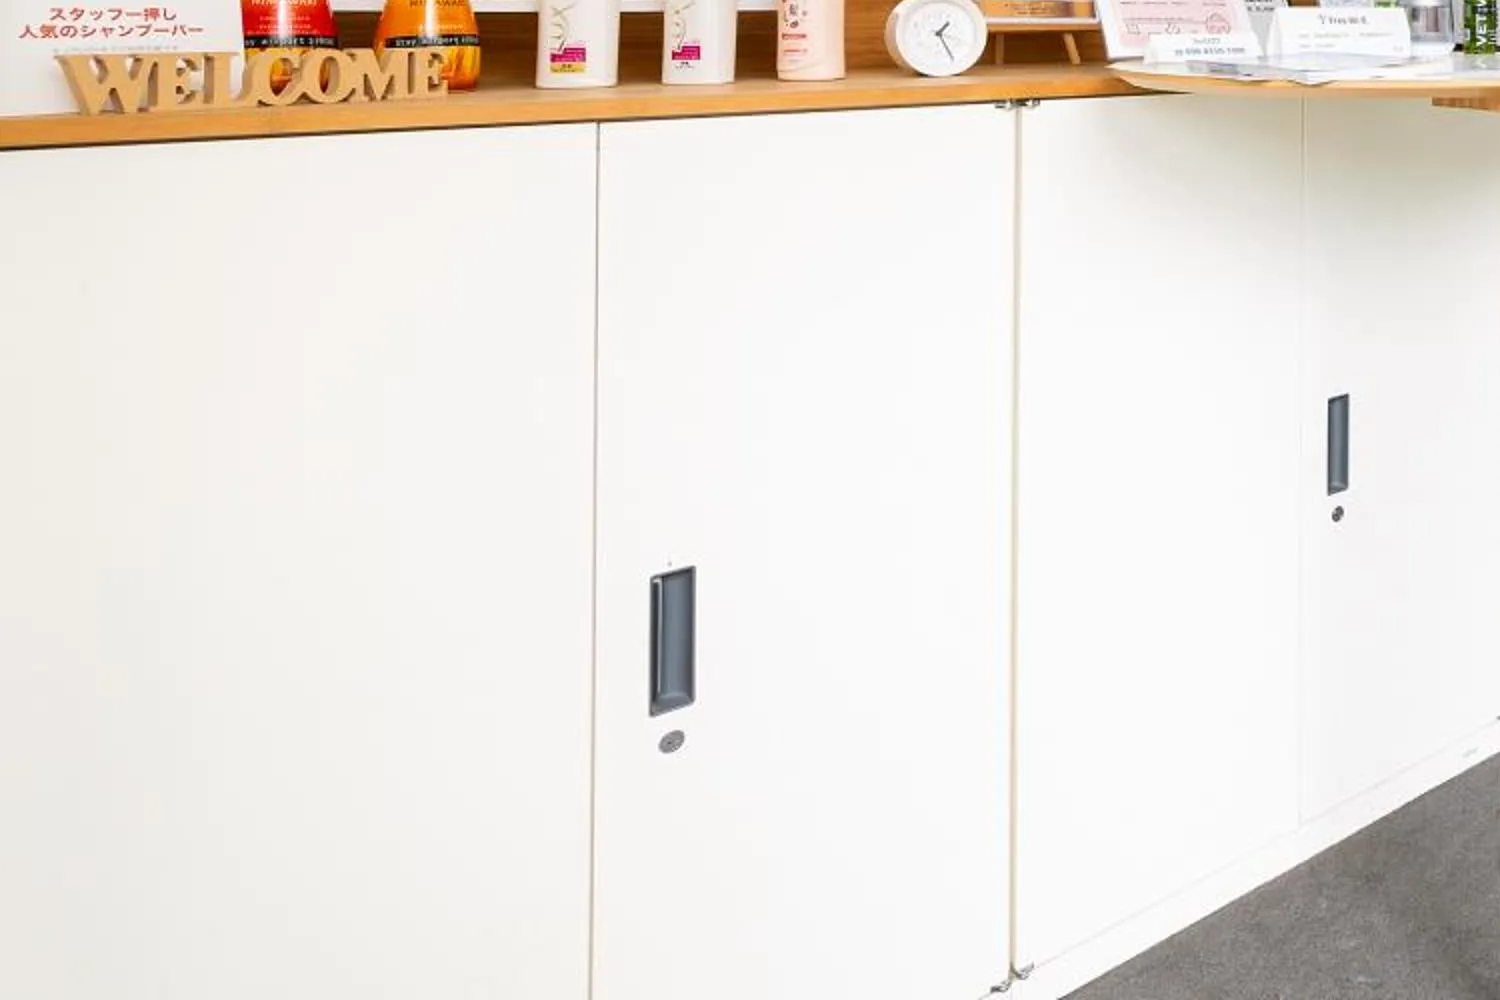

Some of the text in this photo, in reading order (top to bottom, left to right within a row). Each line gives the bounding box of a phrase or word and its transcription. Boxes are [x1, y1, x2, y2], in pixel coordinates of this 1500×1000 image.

[49, 7, 177, 22] スタッフ一押し
[19, 24, 205, 39] 人気のシャンプーバー
[53, 49, 449, 116] WELCOME
